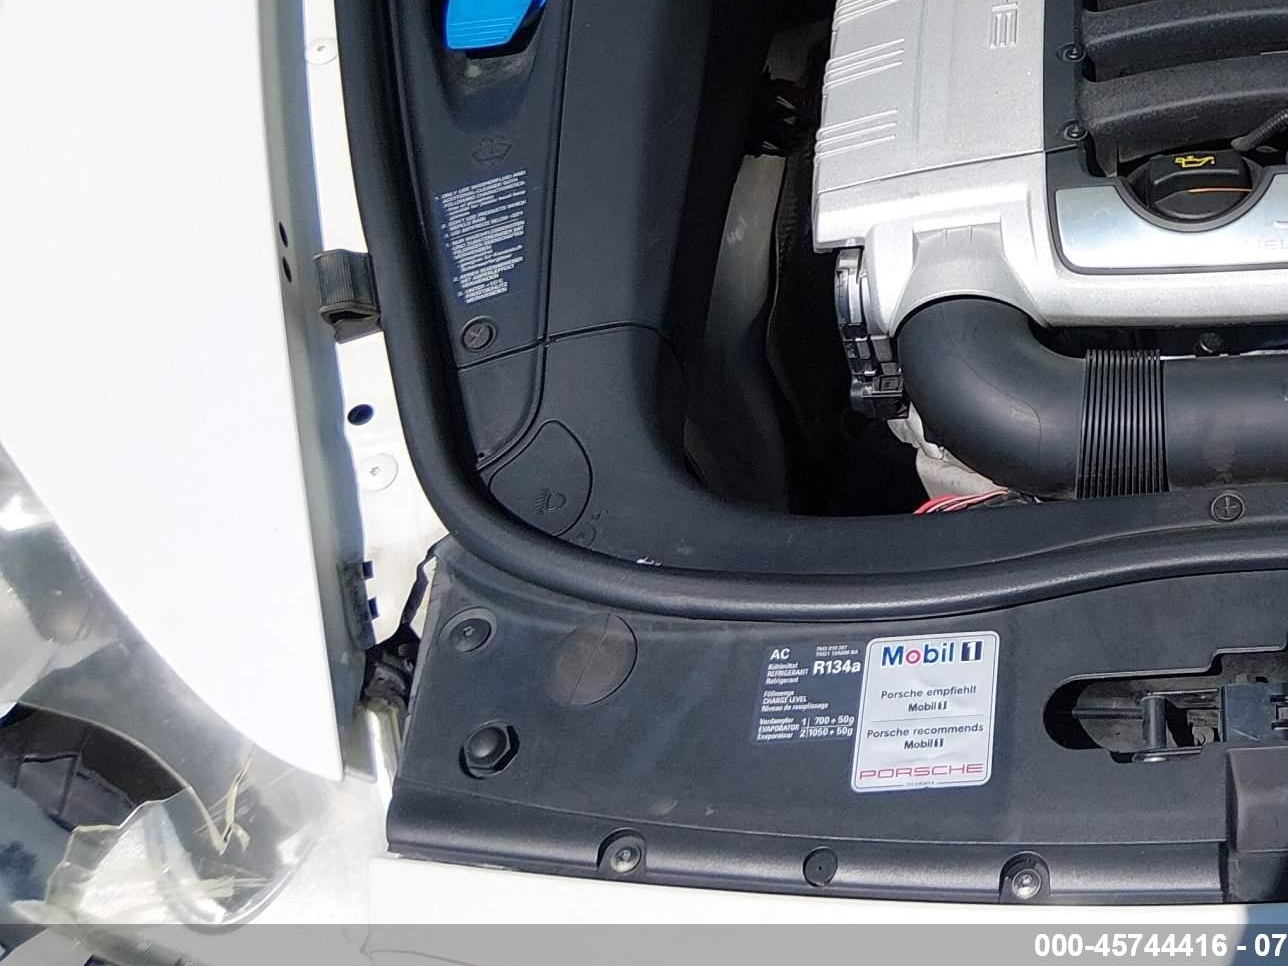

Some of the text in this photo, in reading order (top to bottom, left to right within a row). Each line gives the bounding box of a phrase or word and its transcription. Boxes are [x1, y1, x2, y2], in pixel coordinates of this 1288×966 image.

[769, 647, 791, 660] AC
[881, 642, 955, 666] Mobil
[812, 659, 861, 675] R134a
[880, 685, 977, 700] Porsche empfiehlt
[908, 702, 937, 712] Mobil
[866, 722, 984, 739] Porsche recommends
[904, 740, 933, 750] Mobil
[859, 763, 984, 780] PORSCHE
